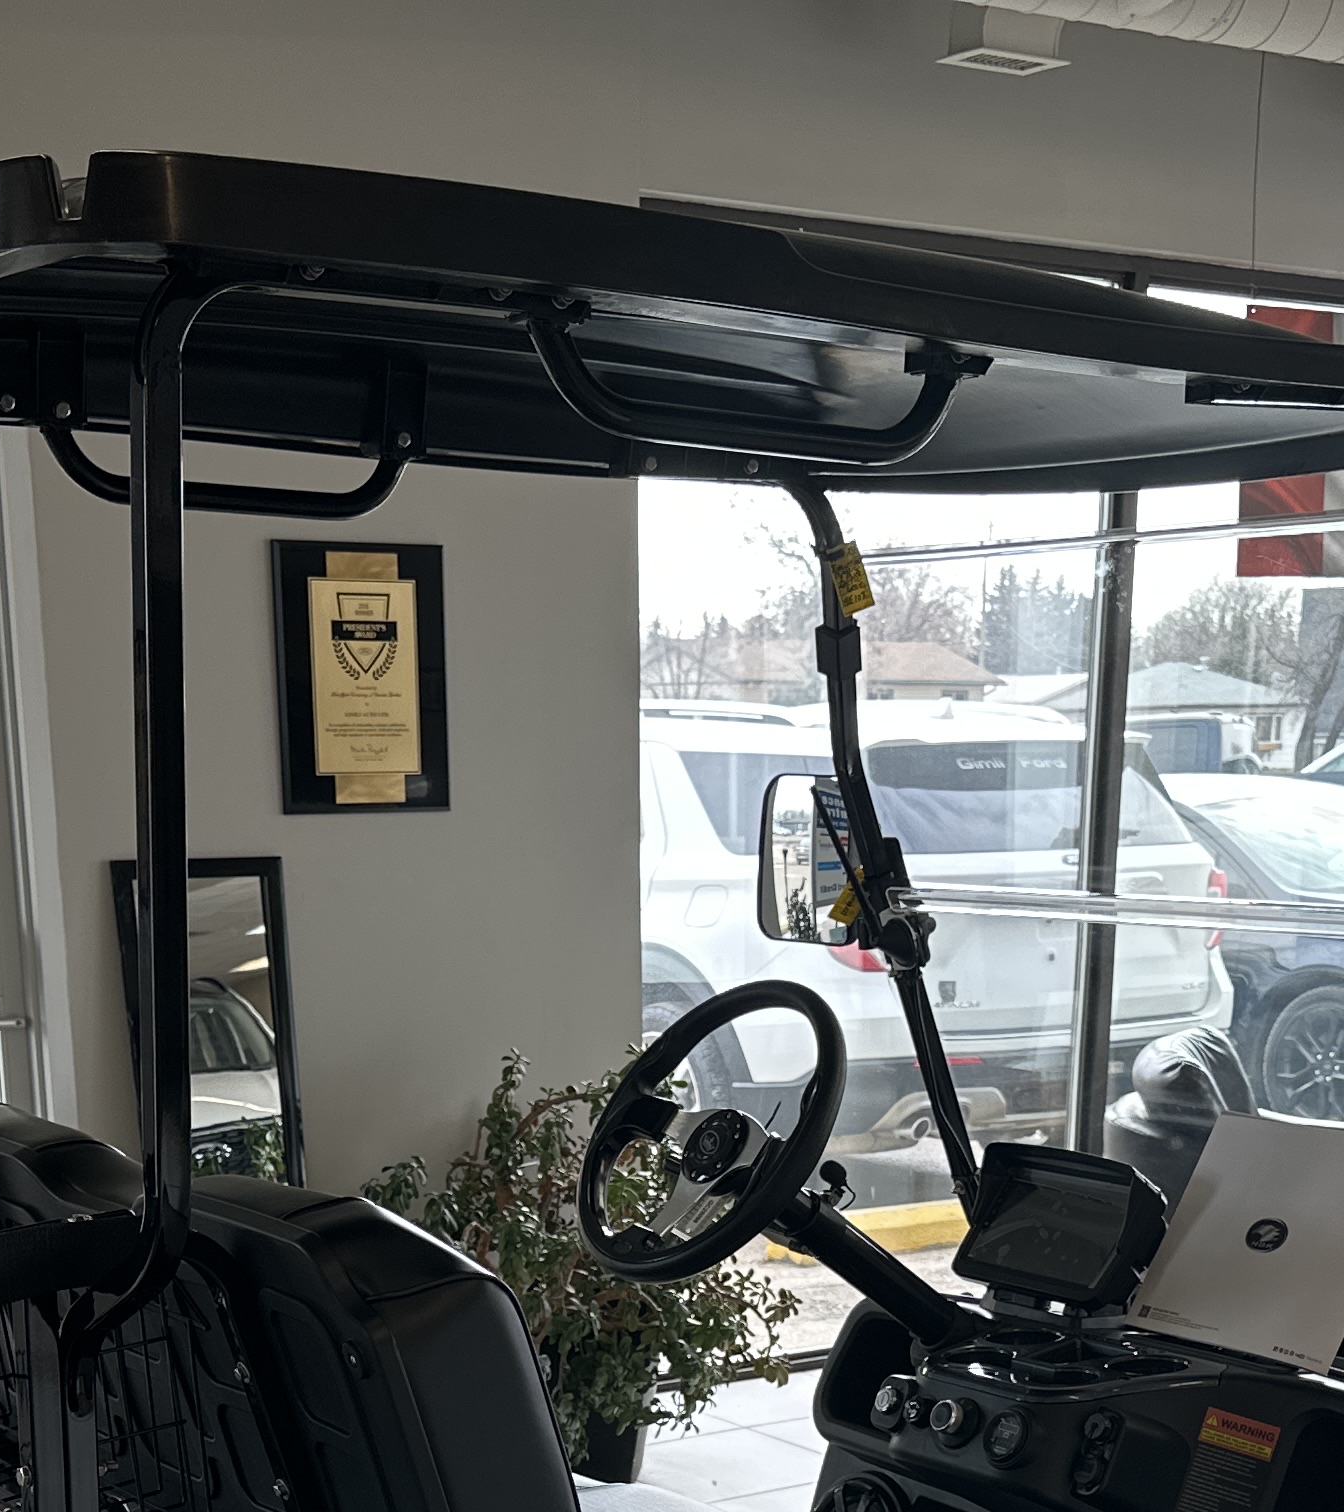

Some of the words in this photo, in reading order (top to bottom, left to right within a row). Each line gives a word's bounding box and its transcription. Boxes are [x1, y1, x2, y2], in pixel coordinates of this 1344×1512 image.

[956, 757, 1006, 770] Gimli
[1019, 758, 1068, 769] Ford
[1221, 1417, 1275, 1442] WARNING
